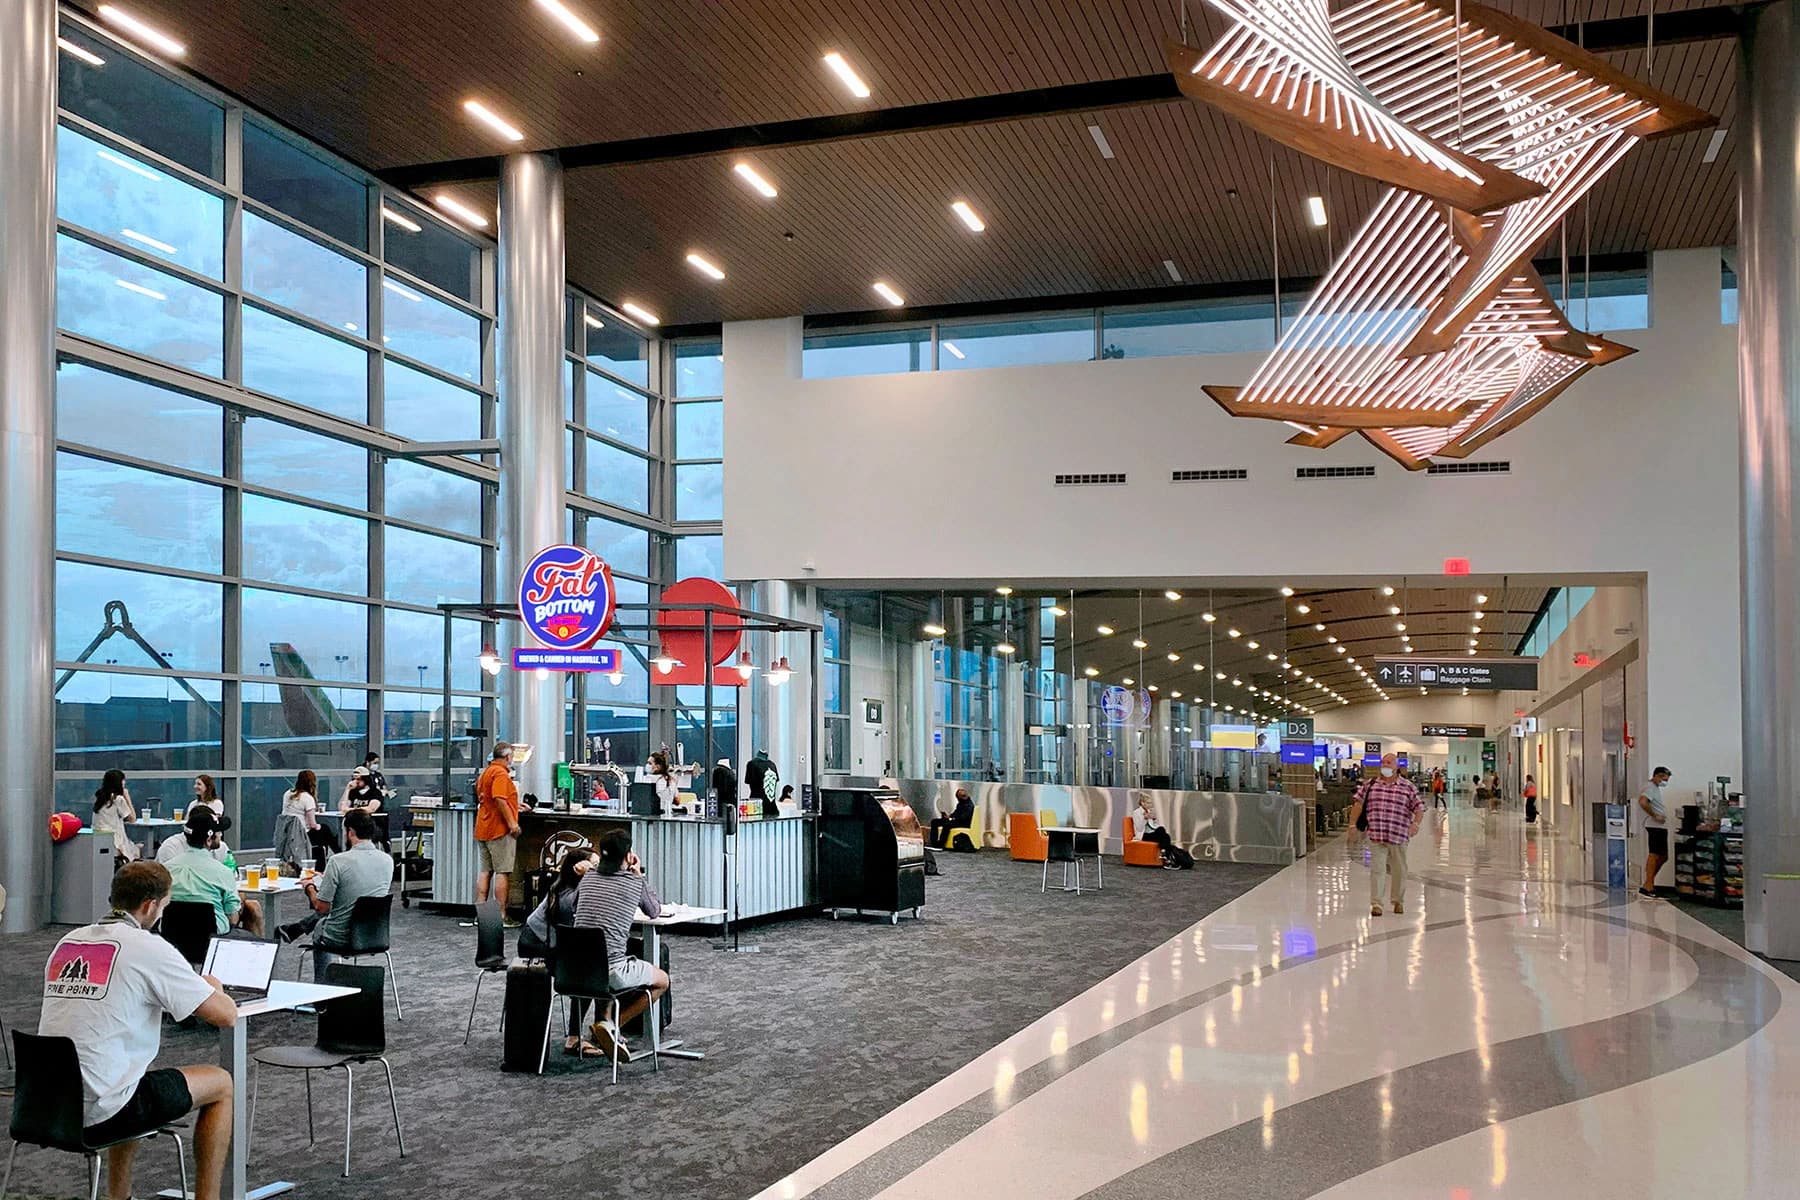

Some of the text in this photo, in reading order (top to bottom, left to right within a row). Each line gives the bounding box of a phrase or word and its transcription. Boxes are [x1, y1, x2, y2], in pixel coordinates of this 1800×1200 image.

[527, 555, 604, 603] Fat
[534, 599, 595, 623] BOTTOM
[1469, 667, 1490, 675] Gates
[1440, 675, 1471, 684] Baggage
[1288, 722, 1308, 735] D3
[1367, 744, 1379, 752] D2
[66, 984, 98, 996] POINT
